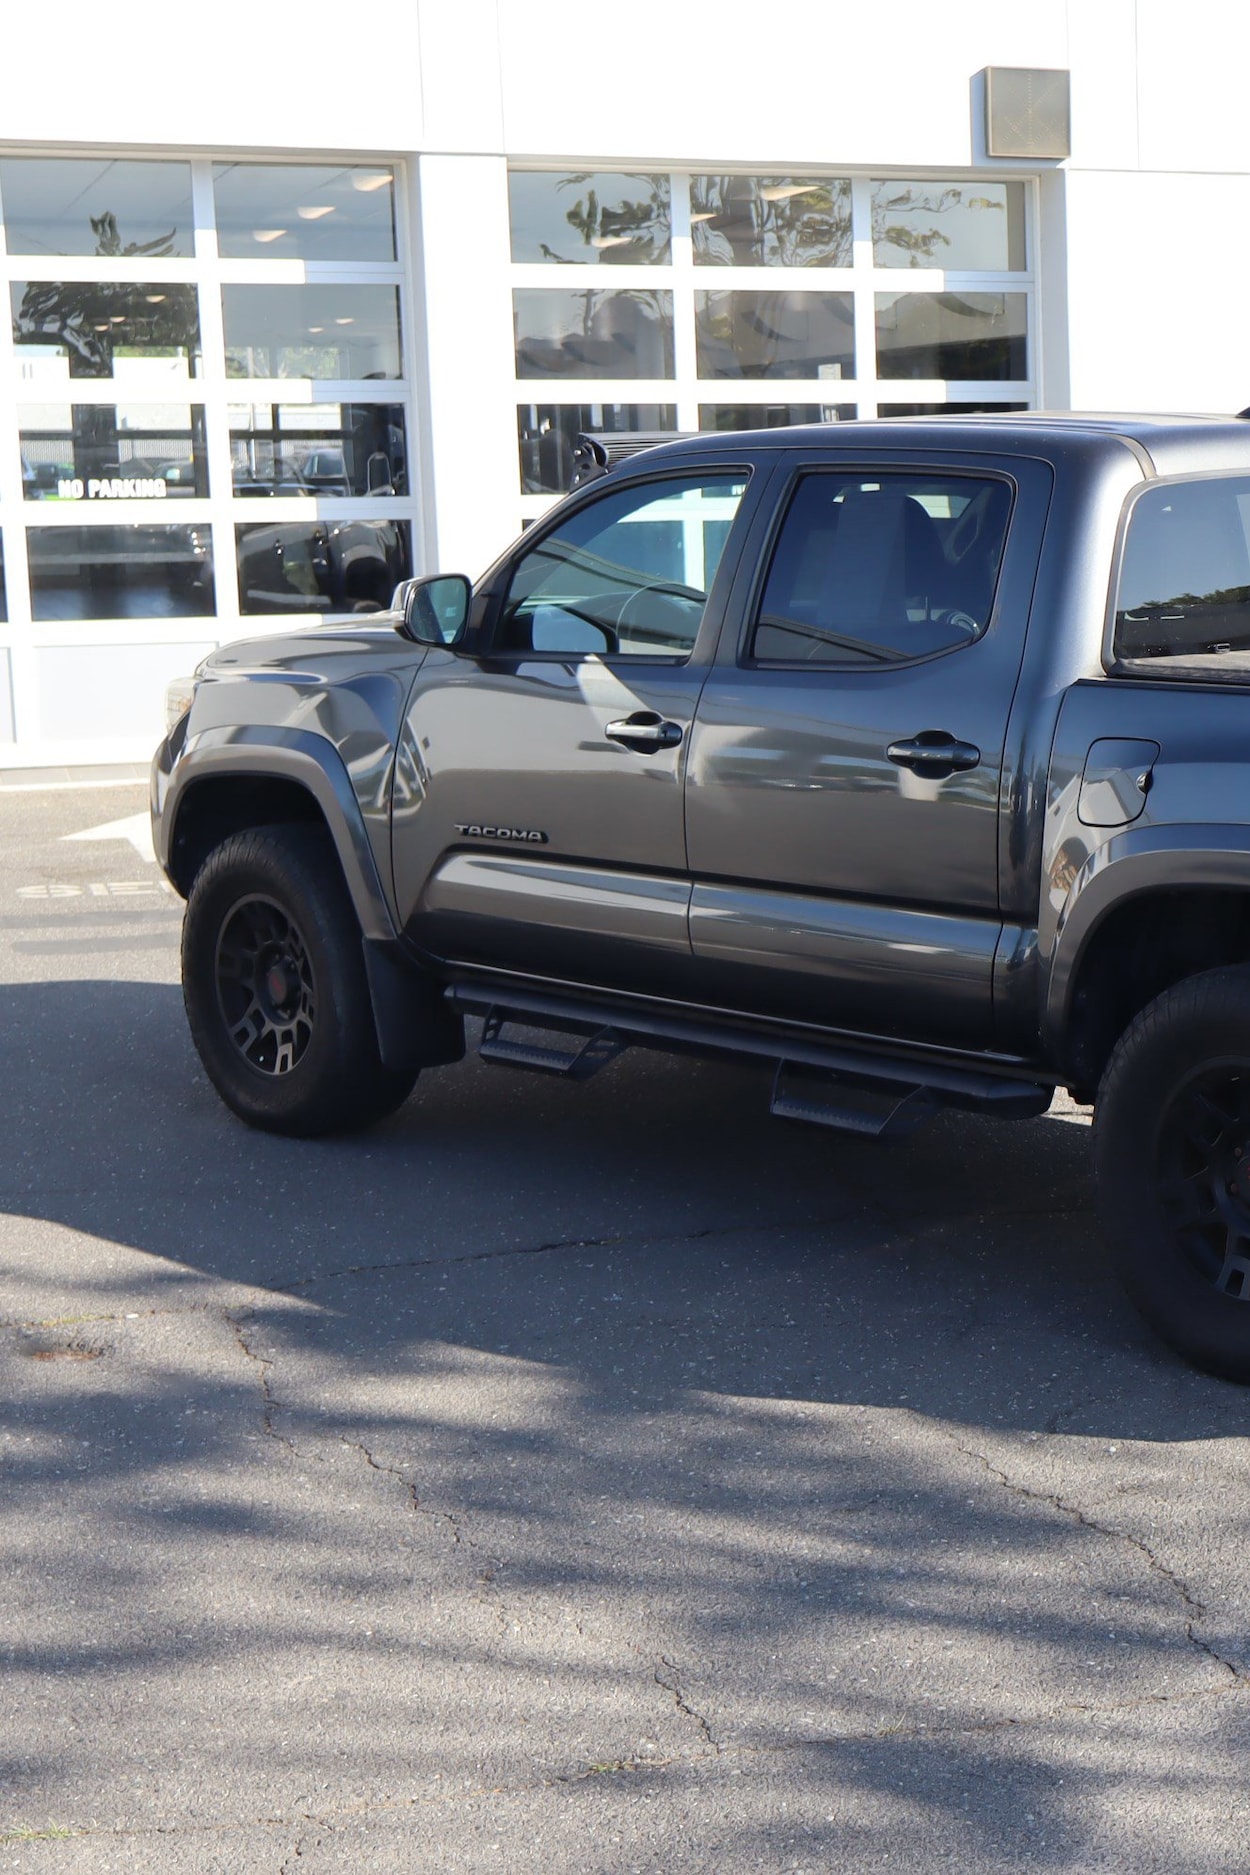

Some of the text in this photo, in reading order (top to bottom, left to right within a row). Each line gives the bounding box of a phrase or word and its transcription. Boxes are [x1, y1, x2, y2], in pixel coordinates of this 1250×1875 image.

[58, 478, 167, 498] NO PARKING
[453, 823, 544, 842] TACOMA
